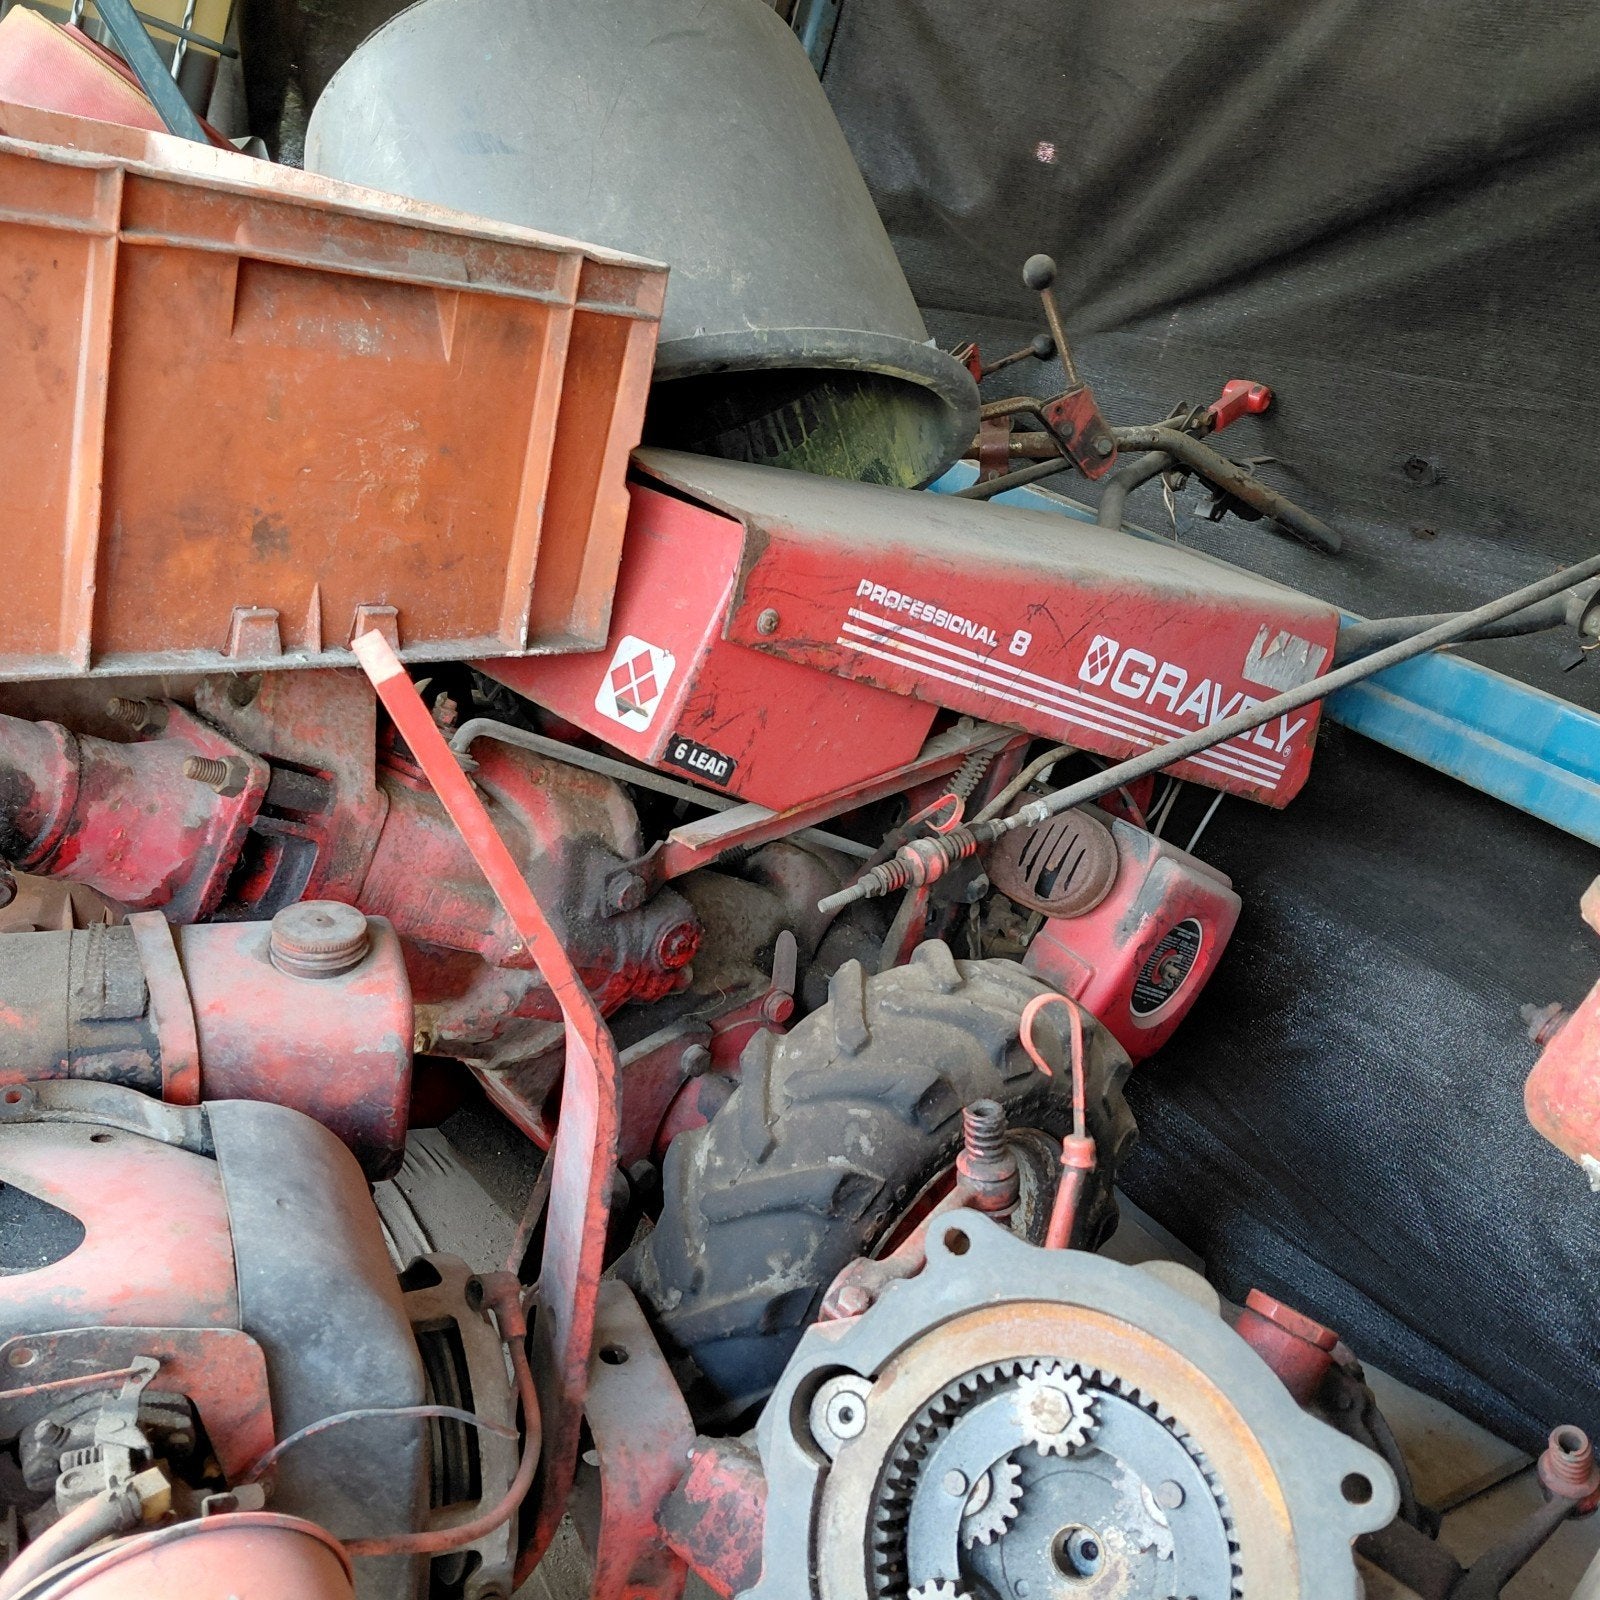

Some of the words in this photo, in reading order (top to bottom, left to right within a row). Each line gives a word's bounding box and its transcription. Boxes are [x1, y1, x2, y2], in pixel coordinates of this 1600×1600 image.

[856, 578, 998, 648] PROFESSIONAL
[1008, 629, 1033, 657] 8
[674, 742, 688, 760] 6
[687, 748, 728, 778] LEAD
